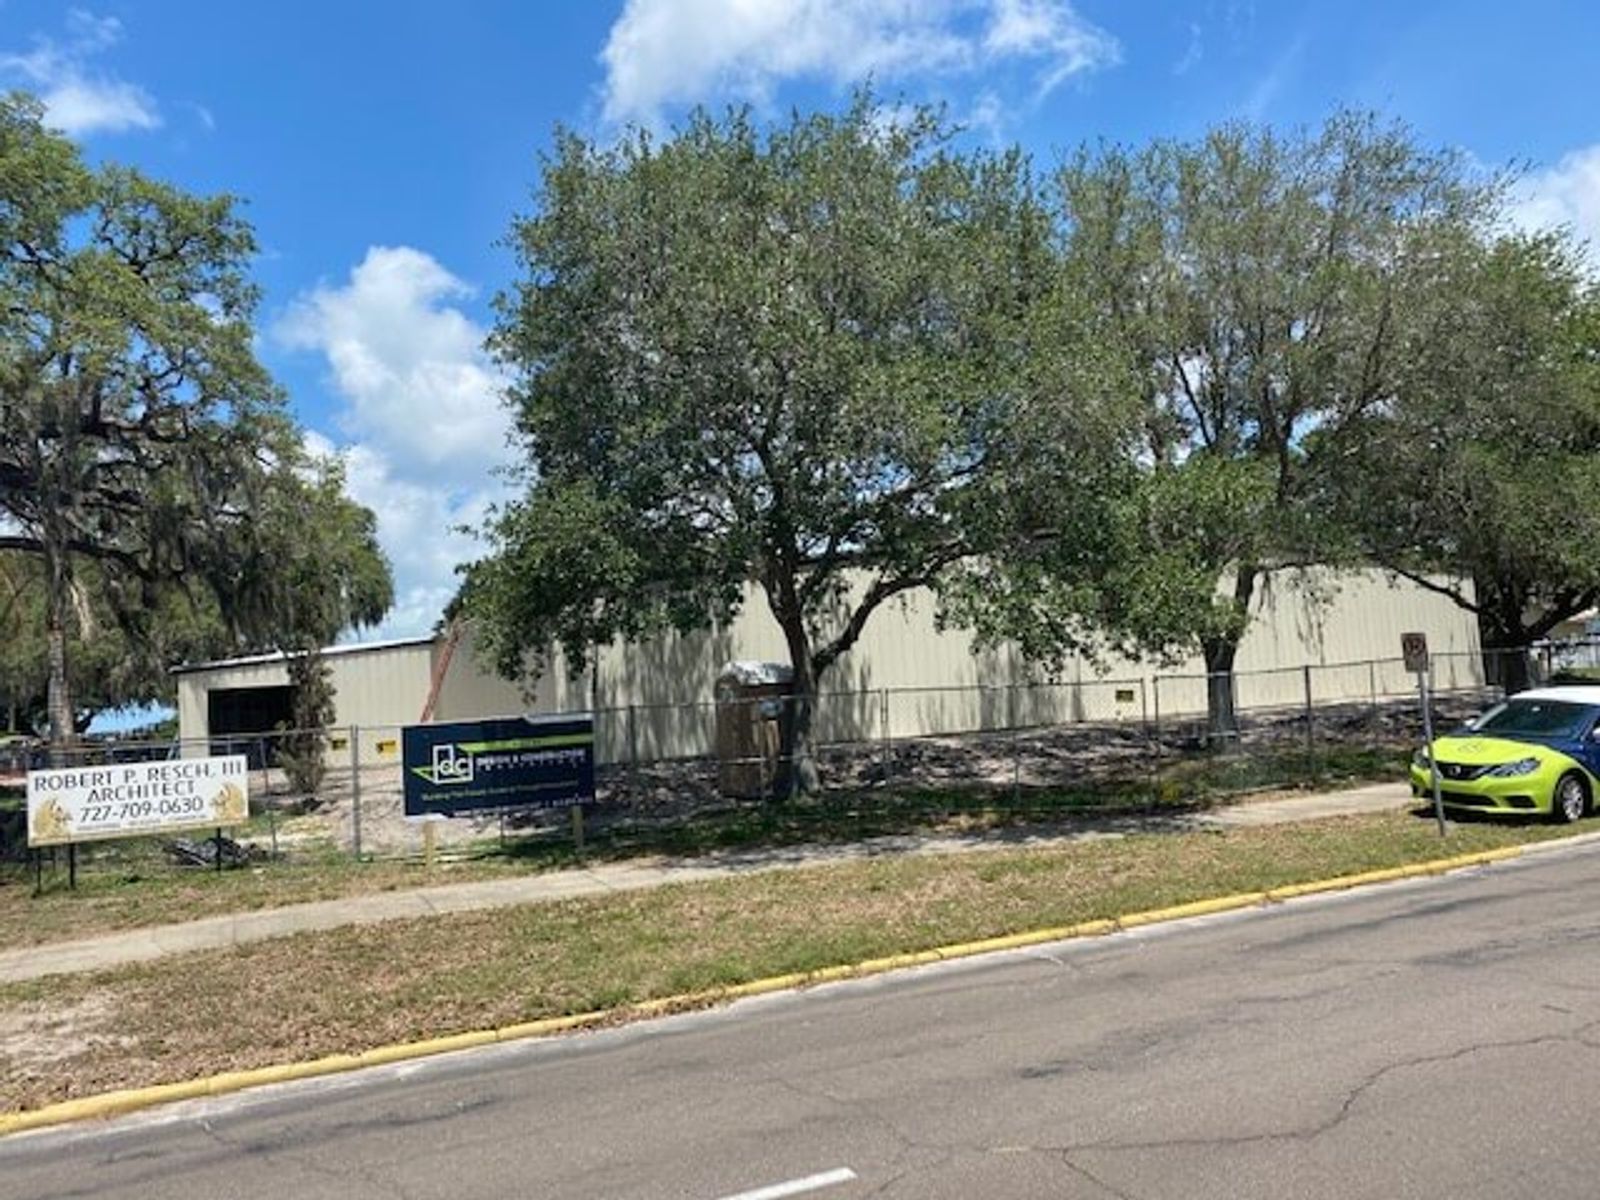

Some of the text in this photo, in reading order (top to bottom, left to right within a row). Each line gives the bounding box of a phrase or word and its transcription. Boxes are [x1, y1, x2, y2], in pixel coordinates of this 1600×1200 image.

[34, 771, 112, 792] ROBERT
[125, 769, 138, 783] P.
[222, 761, 242, 775] III
[87, 780, 196, 803] ARCHITECT
[79, 797, 204, 823] 727-709-0630
